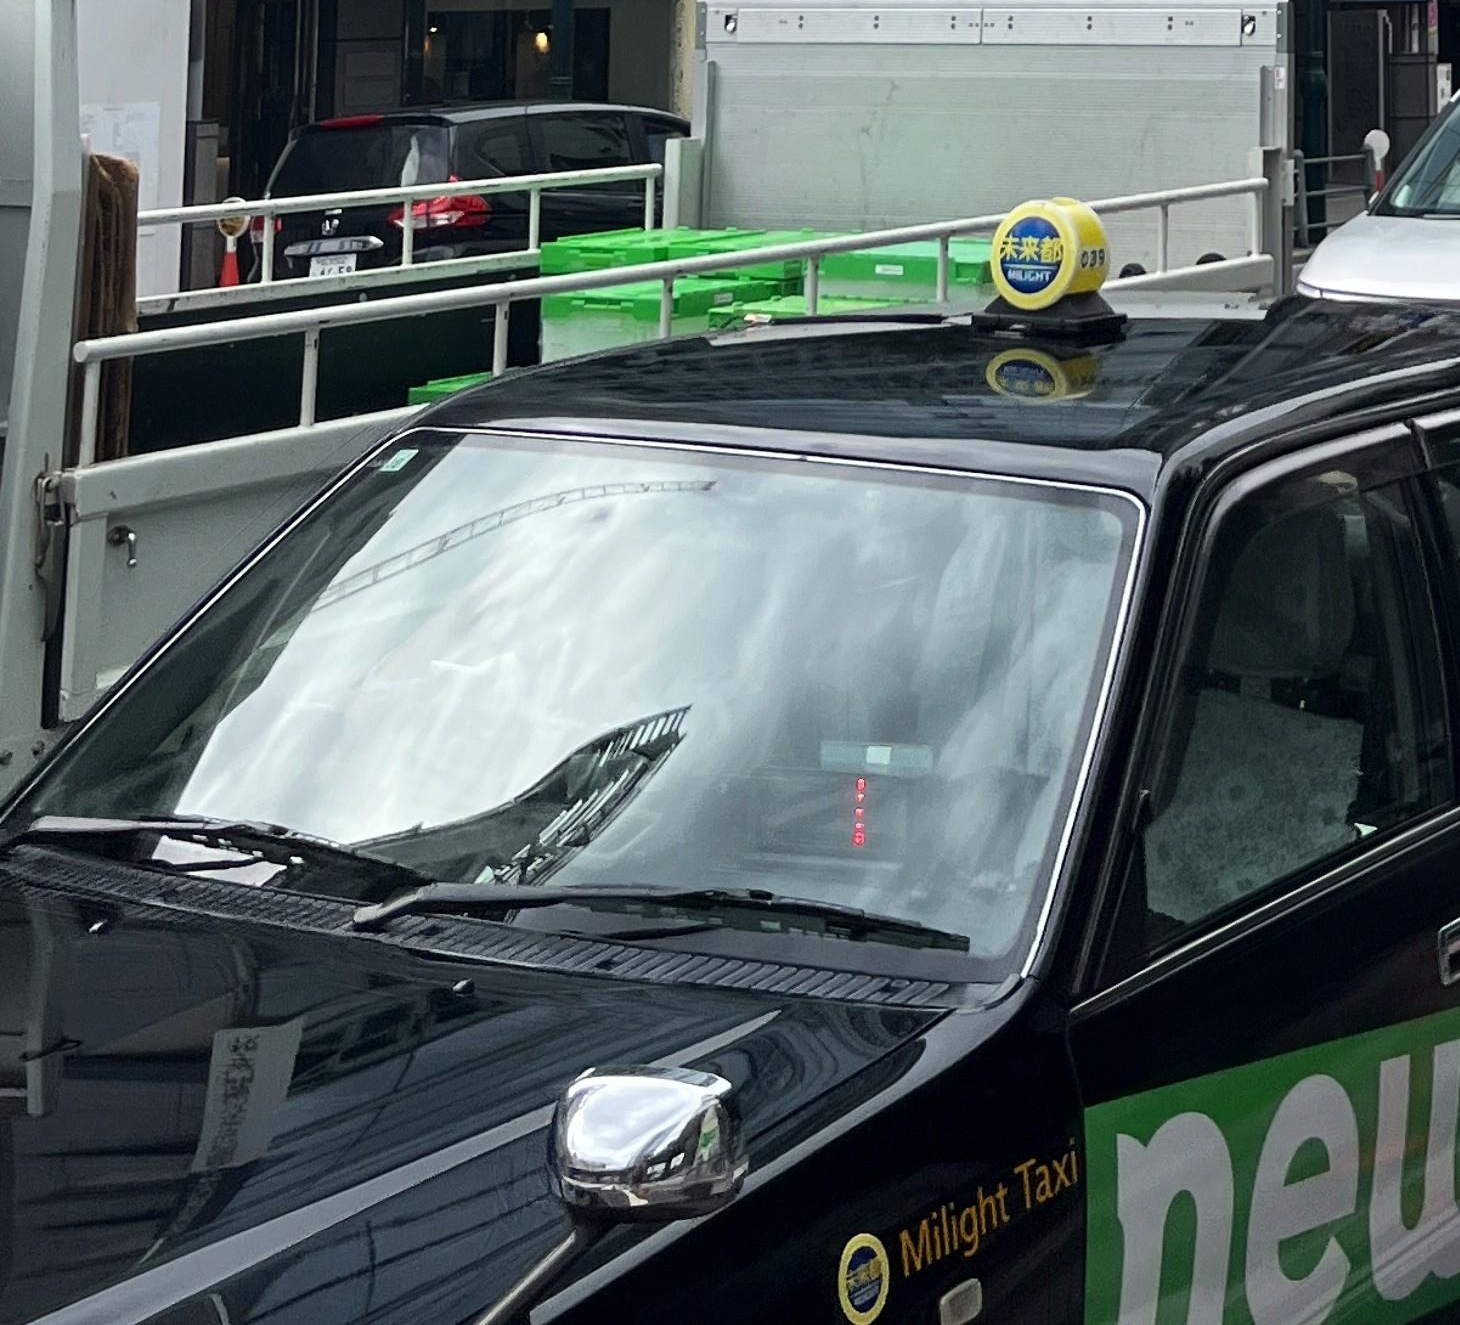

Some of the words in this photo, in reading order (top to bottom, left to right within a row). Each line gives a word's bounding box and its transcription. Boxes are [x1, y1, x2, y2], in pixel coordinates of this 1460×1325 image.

[1000, 234, 1063, 264] 未来都
[1080, 248, 1106, 269] 039
[1007, 268, 1052, 282] MILIGHT
[899, 1182, 1011, 1278] Milight
[1013, 1136, 1079, 1210] Taxi
